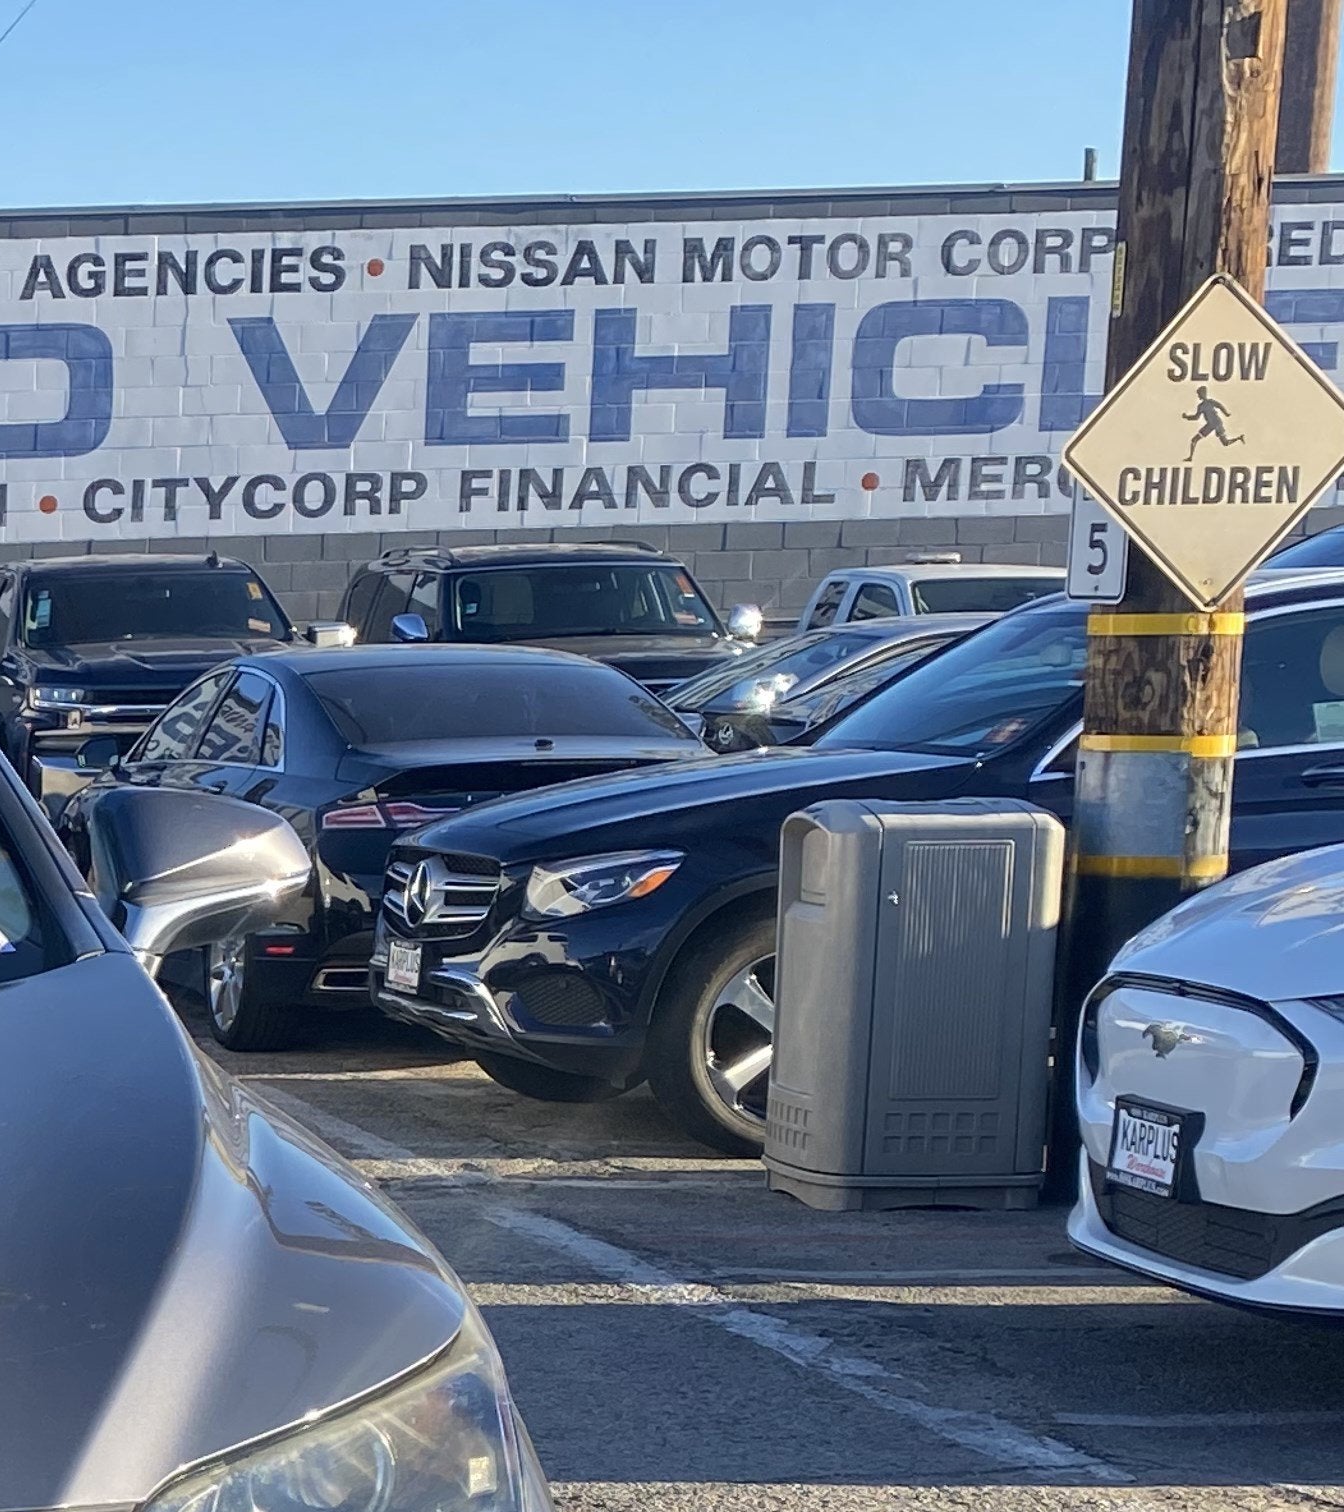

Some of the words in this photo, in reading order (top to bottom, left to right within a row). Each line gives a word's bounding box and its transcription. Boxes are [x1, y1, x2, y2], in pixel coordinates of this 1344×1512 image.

[19, 245, 346, 300] AGENCIES
[407, 239, 657, 290] NISSAN
[681, 232, 913, 285] MOTOR
[941, 227, 1116, 277] CORP
[1167, 341, 1272, 382] SLOW
[83, 470, 428, 524] CITYCORP
[459, 460, 836, 512] FINANCIAL
[1118, 465, 1300, 506] CHILDREN
[1086, 522, 1108, 576] 5
[1119, 1118, 1179, 1164] KARPLUS
